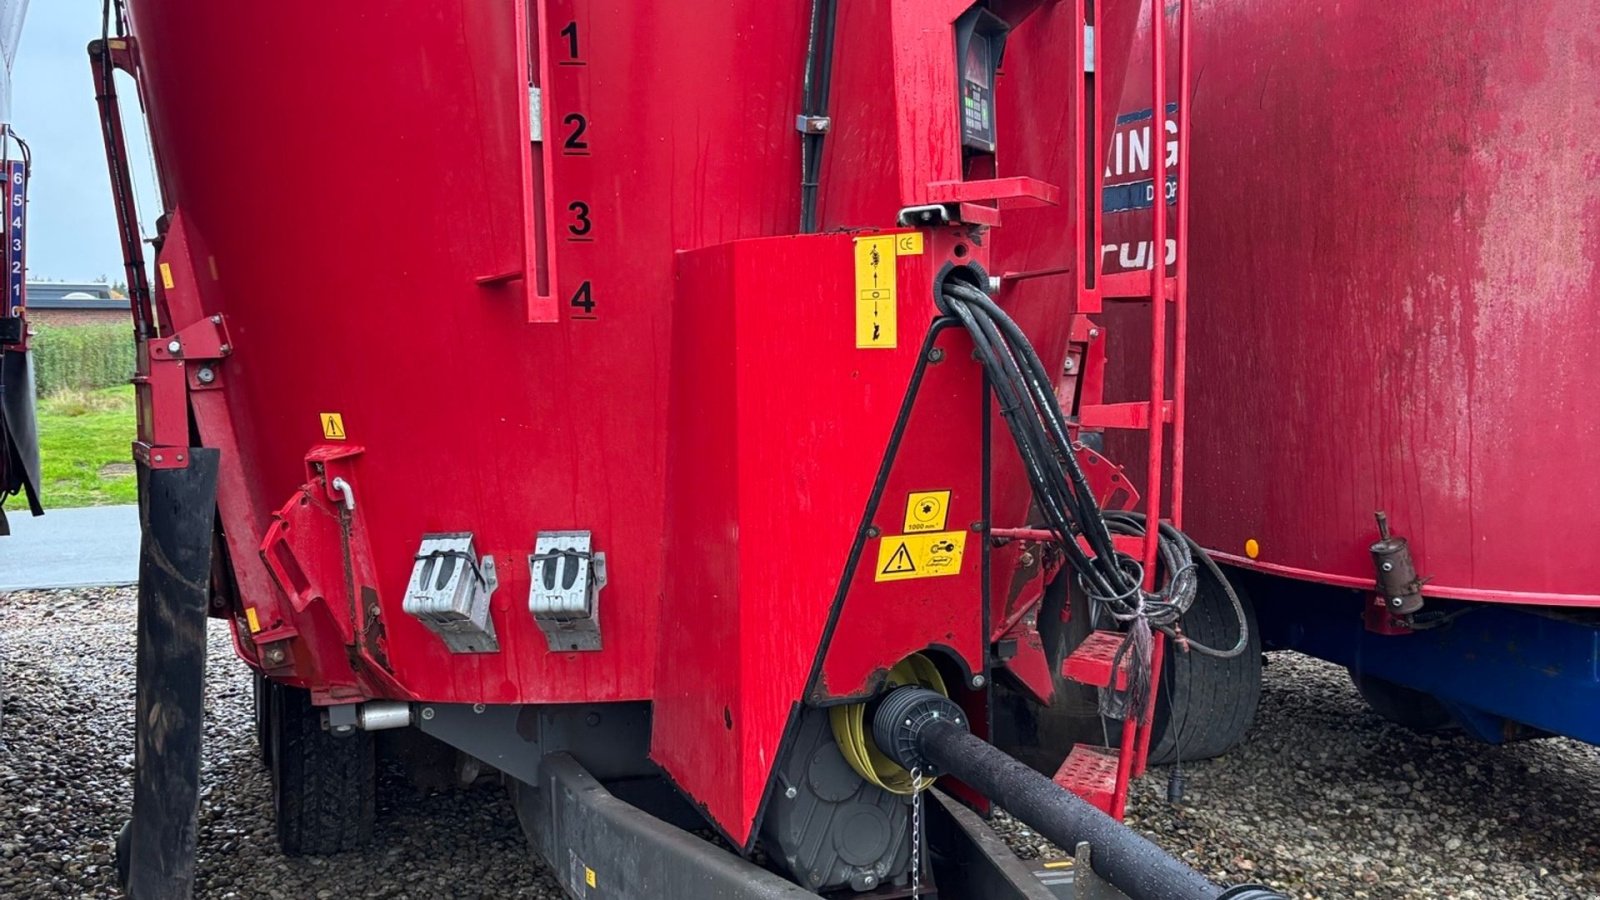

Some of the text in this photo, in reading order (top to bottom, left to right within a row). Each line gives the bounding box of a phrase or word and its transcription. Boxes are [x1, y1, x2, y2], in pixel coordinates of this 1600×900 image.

[560, 21, 578, 58] 1
[563, 113, 588, 149] 2
[1104, 119, 1179, 178] ING
[13, 172, 22, 184] 6
[13, 194, 22, 206] 5
[12, 217, 22, 229] 4
[568, 201, 591, 236] 3
[12, 239, 22, 251] 3
[900, 236, 912, 251] CE
[12, 261, 21, 274] 2
[13, 284, 20, 296] 1
[571, 281, 596, 313] 4
